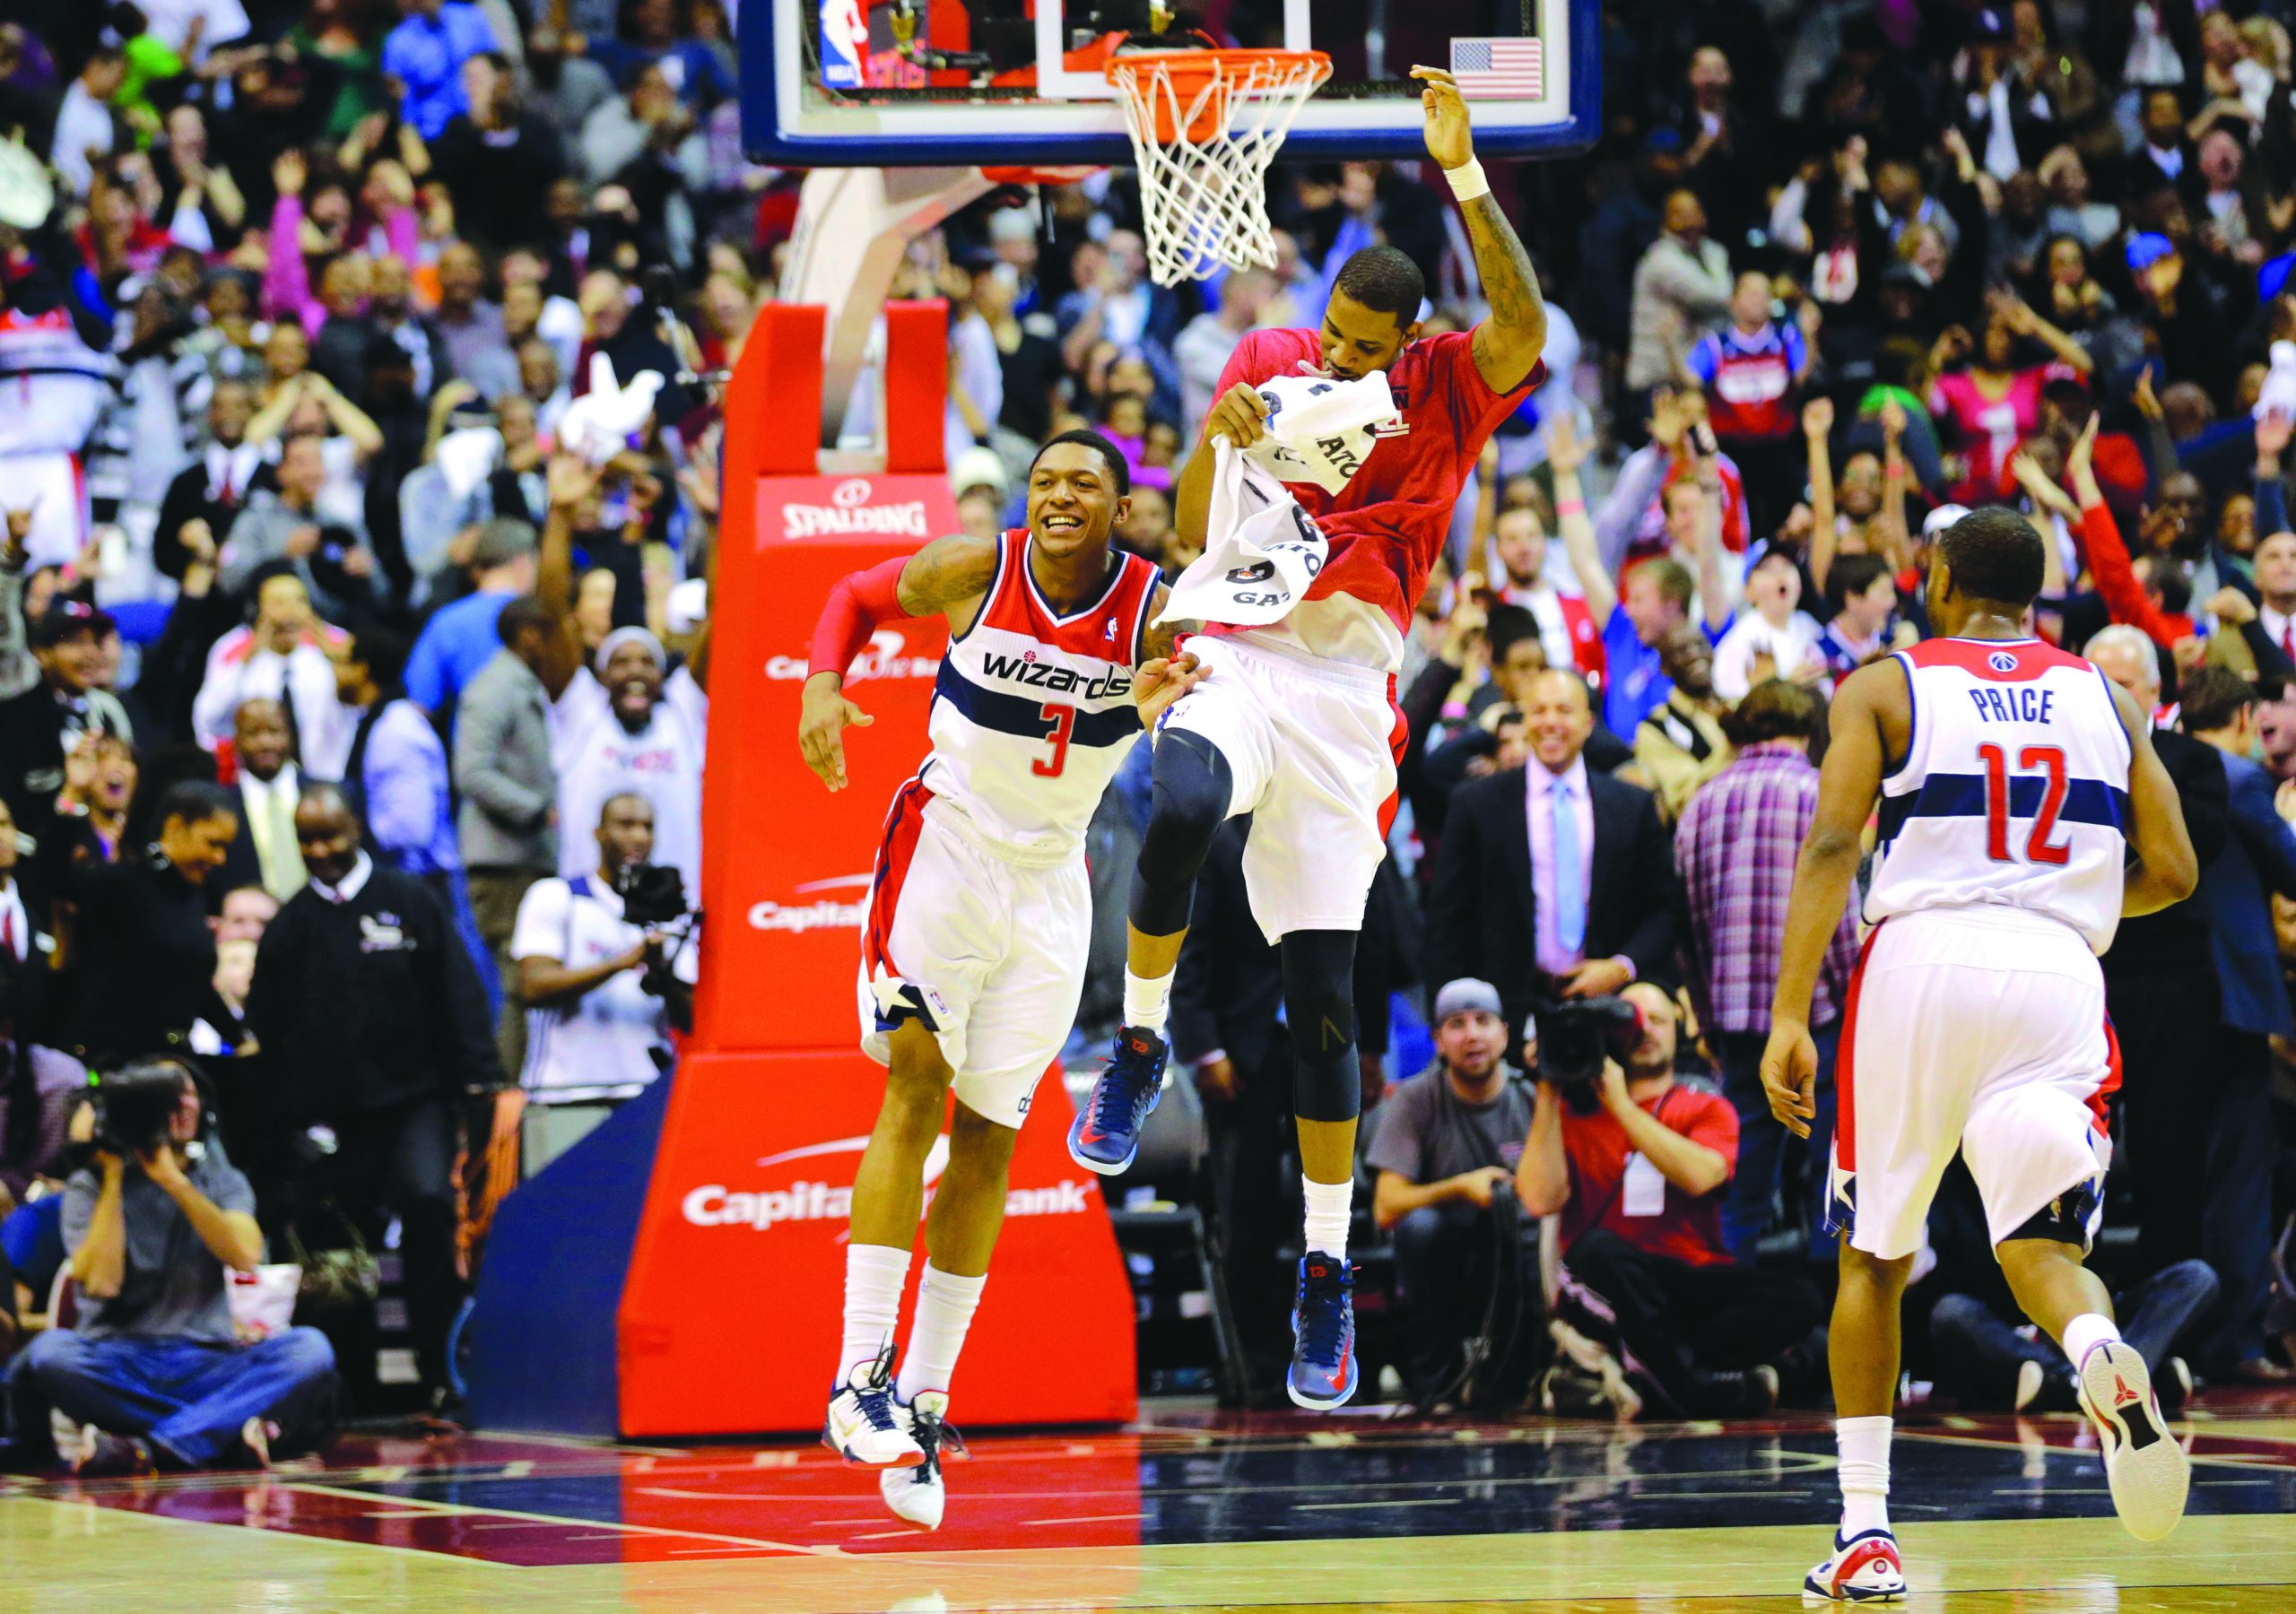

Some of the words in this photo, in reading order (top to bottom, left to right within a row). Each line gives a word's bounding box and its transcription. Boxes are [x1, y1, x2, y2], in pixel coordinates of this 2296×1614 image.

[782, 501, 929, 540] SPALDING
[1968, 688, 2055, 725] PRICE
[1031, 701, 1076, 779] 3
[1977, 741, 2073, 868] 12
[682, 1180, 853, 1231] Capita
[1004, 1179, 1088, 1217] ank
